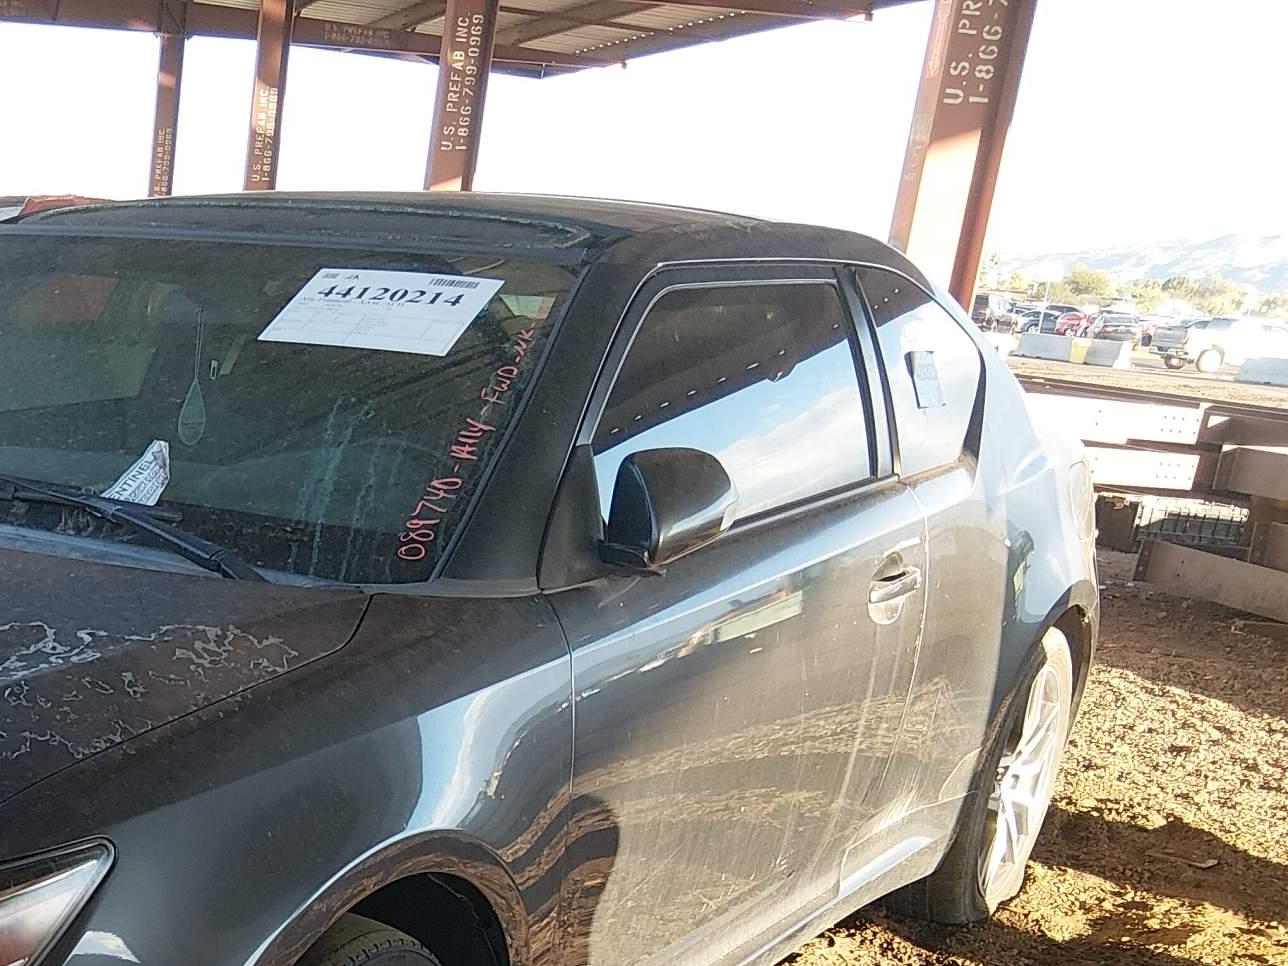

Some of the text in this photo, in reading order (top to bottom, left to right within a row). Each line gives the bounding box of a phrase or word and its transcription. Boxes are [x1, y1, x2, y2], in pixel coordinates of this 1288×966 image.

[440, 12, 471, 151] U.S. PREFAB INC.
[455, 14, 484, 150] 1-866-799-0969
[943, 53, 972, 104] U.S.
[318, 284, 465, 307] 44120214
